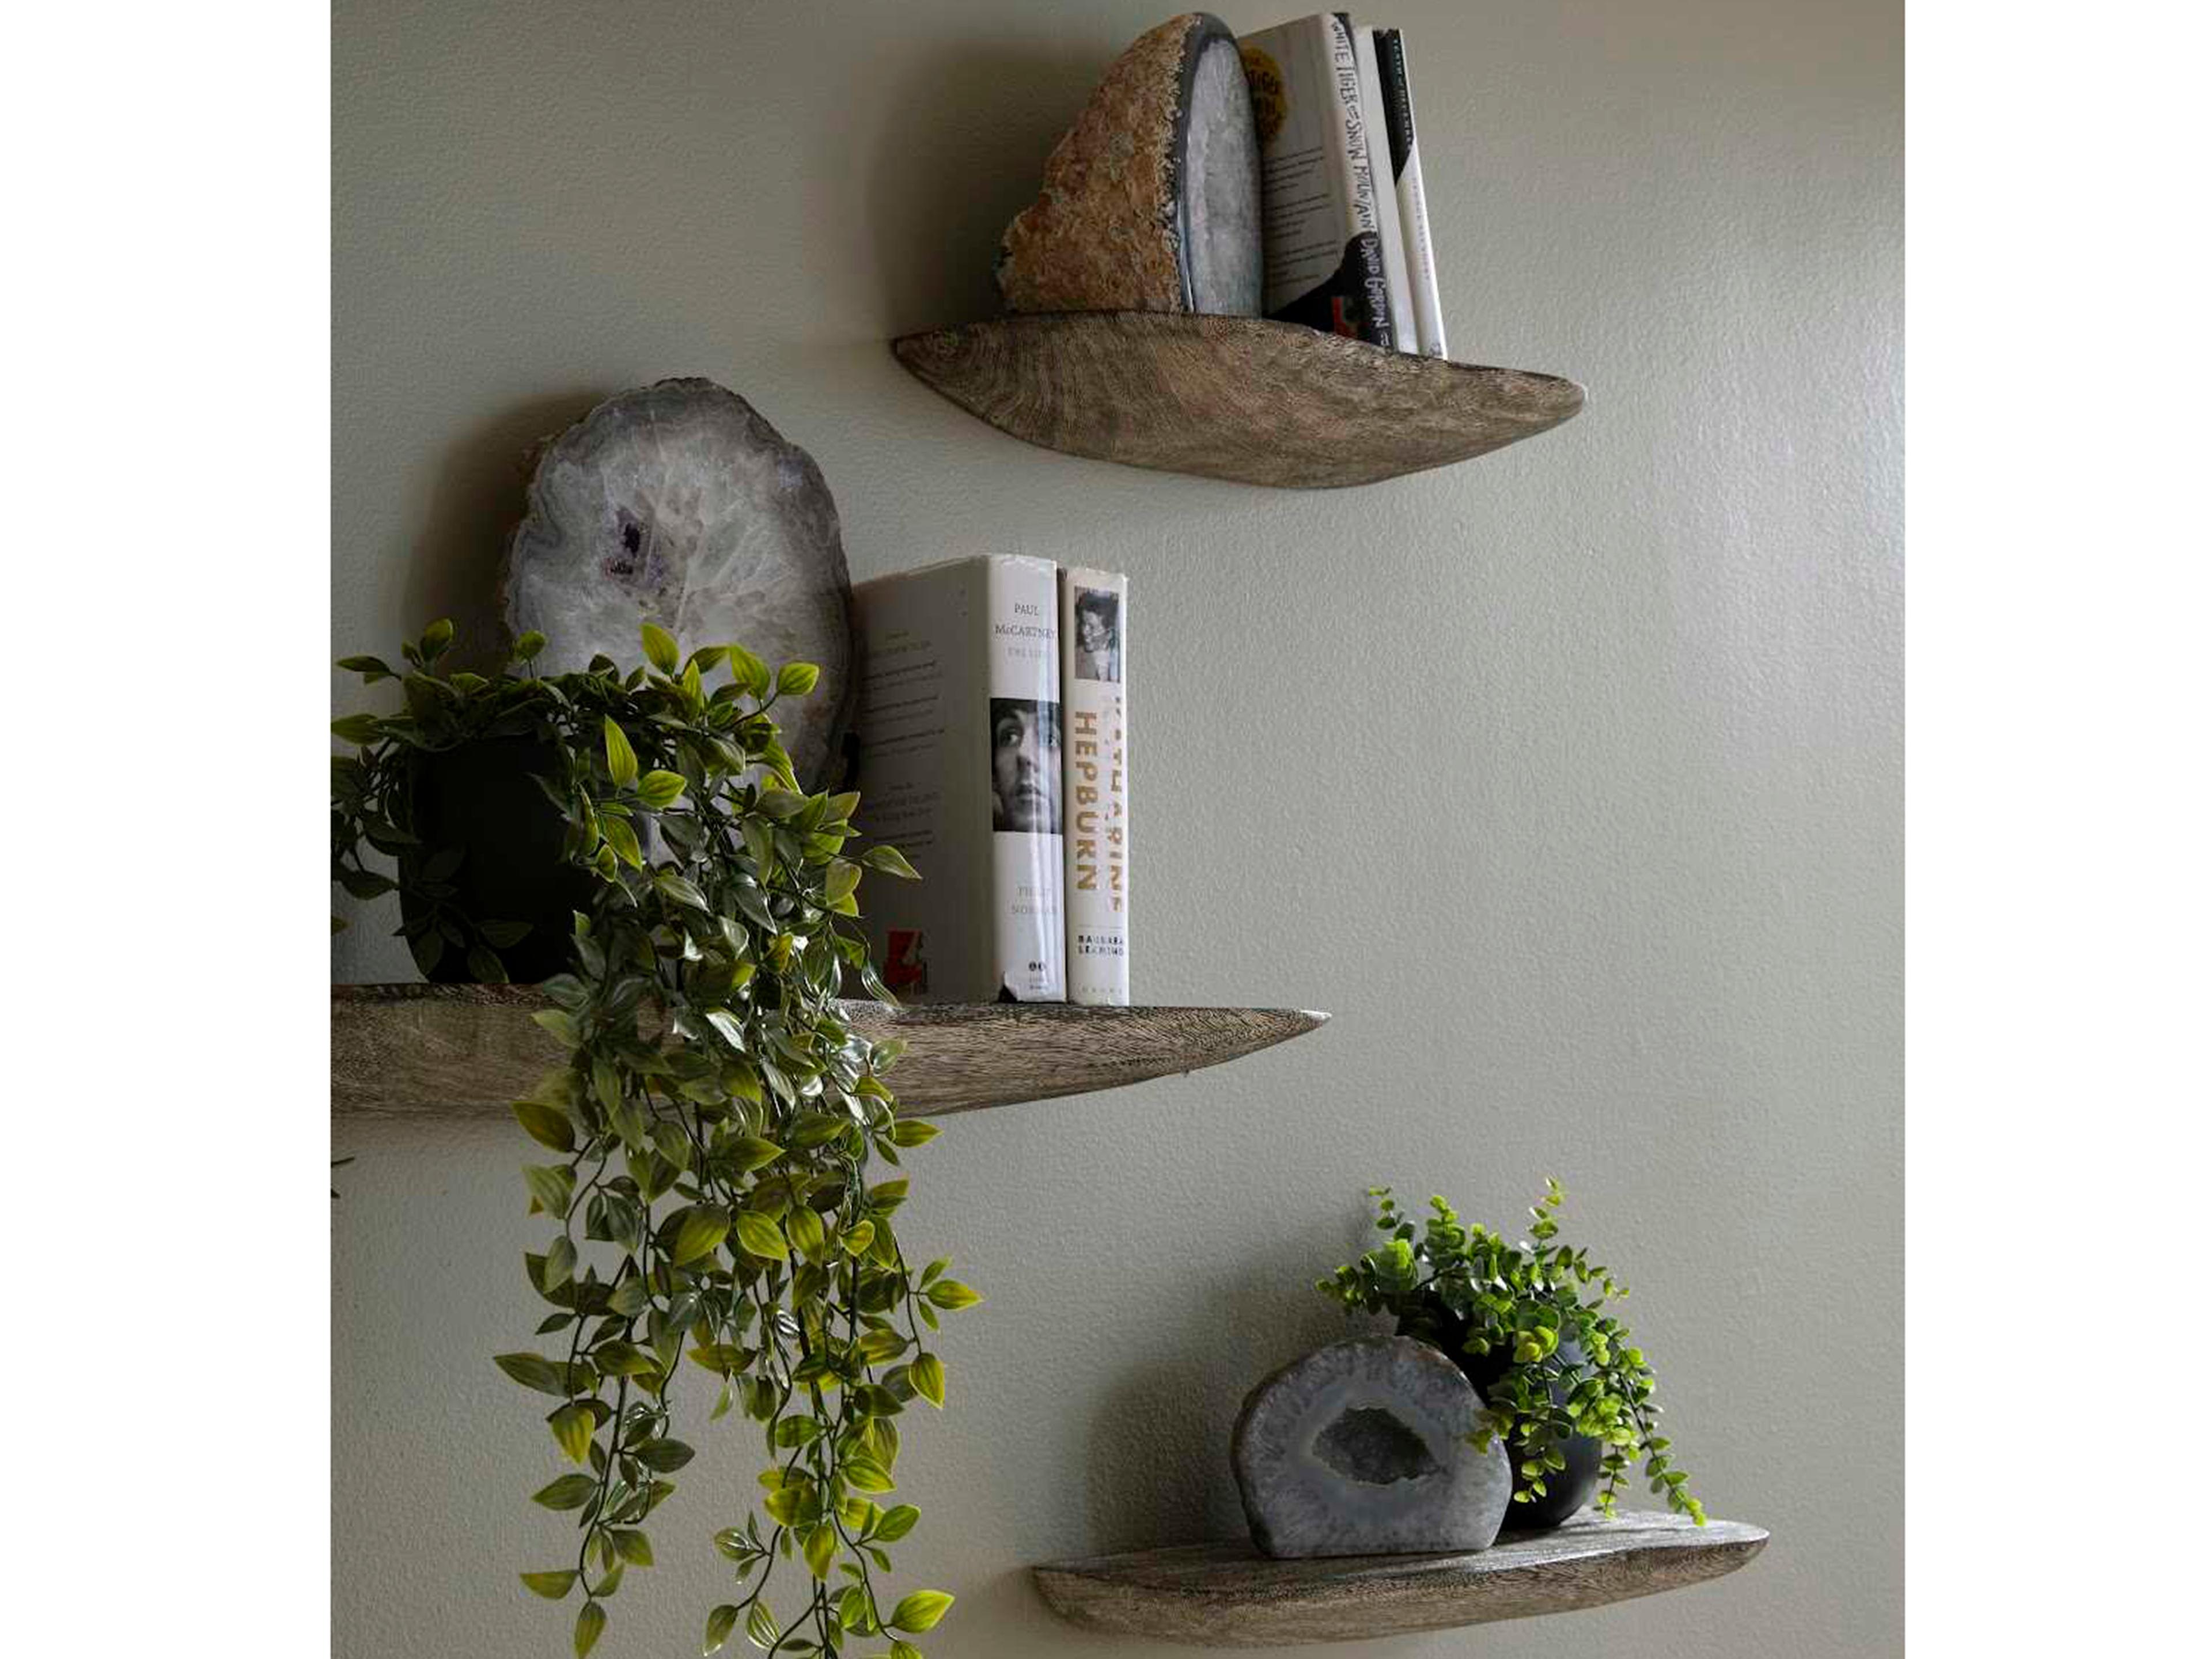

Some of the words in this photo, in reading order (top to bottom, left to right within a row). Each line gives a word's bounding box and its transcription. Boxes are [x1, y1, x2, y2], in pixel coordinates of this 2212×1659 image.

[1345, 119, 1367, 160] SNOW
[1361, 238, 1381, 275] DAVID
[1014, 603, 1039, 616] PAUL
[995, 624, 1055, 639] McCARTNEY
[1074, 711, 1099, 890] HEPBURN
